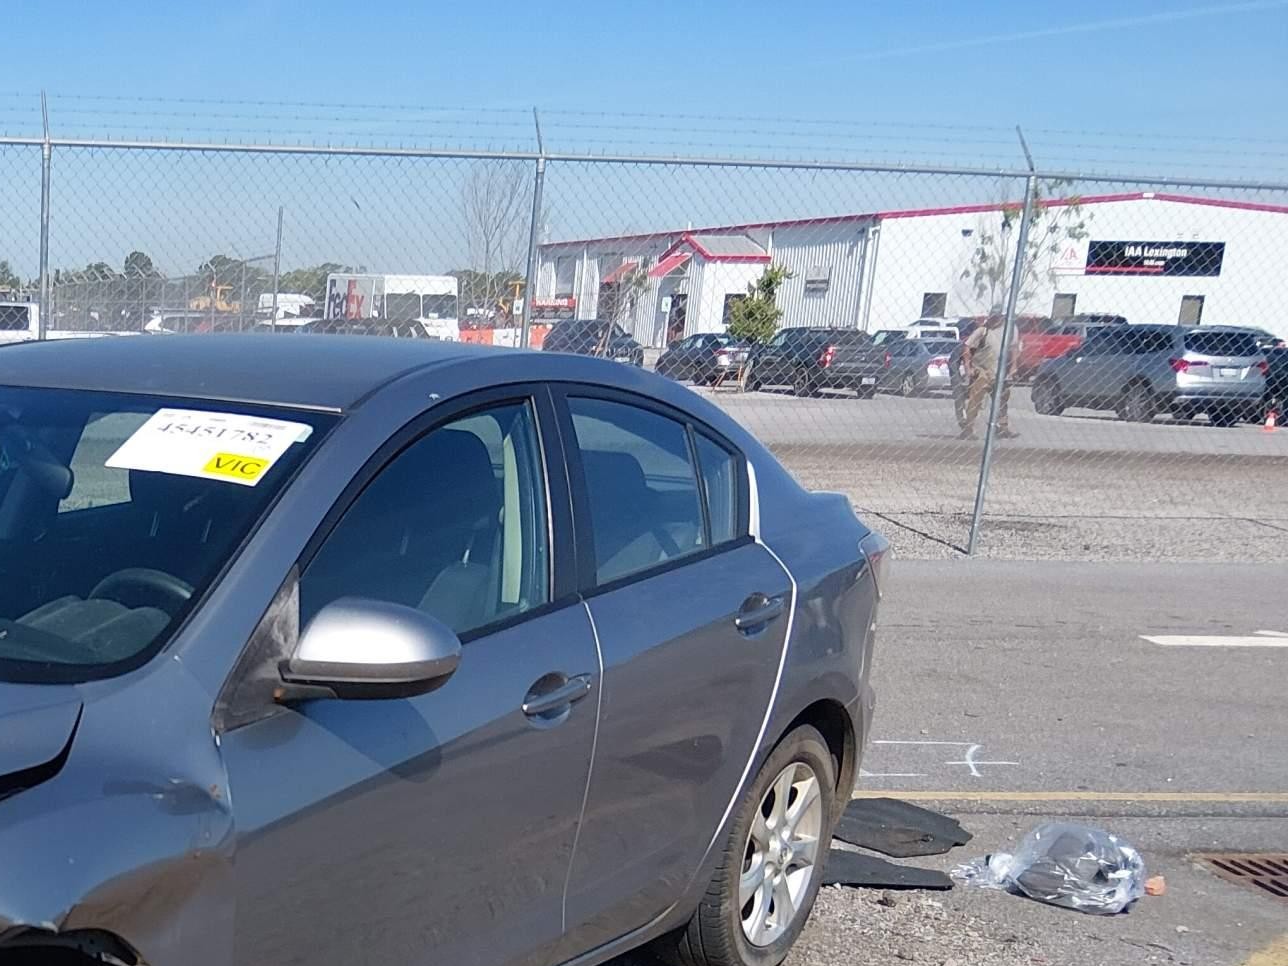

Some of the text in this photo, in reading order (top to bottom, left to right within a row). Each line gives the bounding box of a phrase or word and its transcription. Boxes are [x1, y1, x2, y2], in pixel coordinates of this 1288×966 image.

[1124, 245, 1187, 259] IAA Lexington
[327, 278, 364, 320] FedEx
[157, 422, 274, 445] 45451782
[214, 456, 261, 475] VIC
